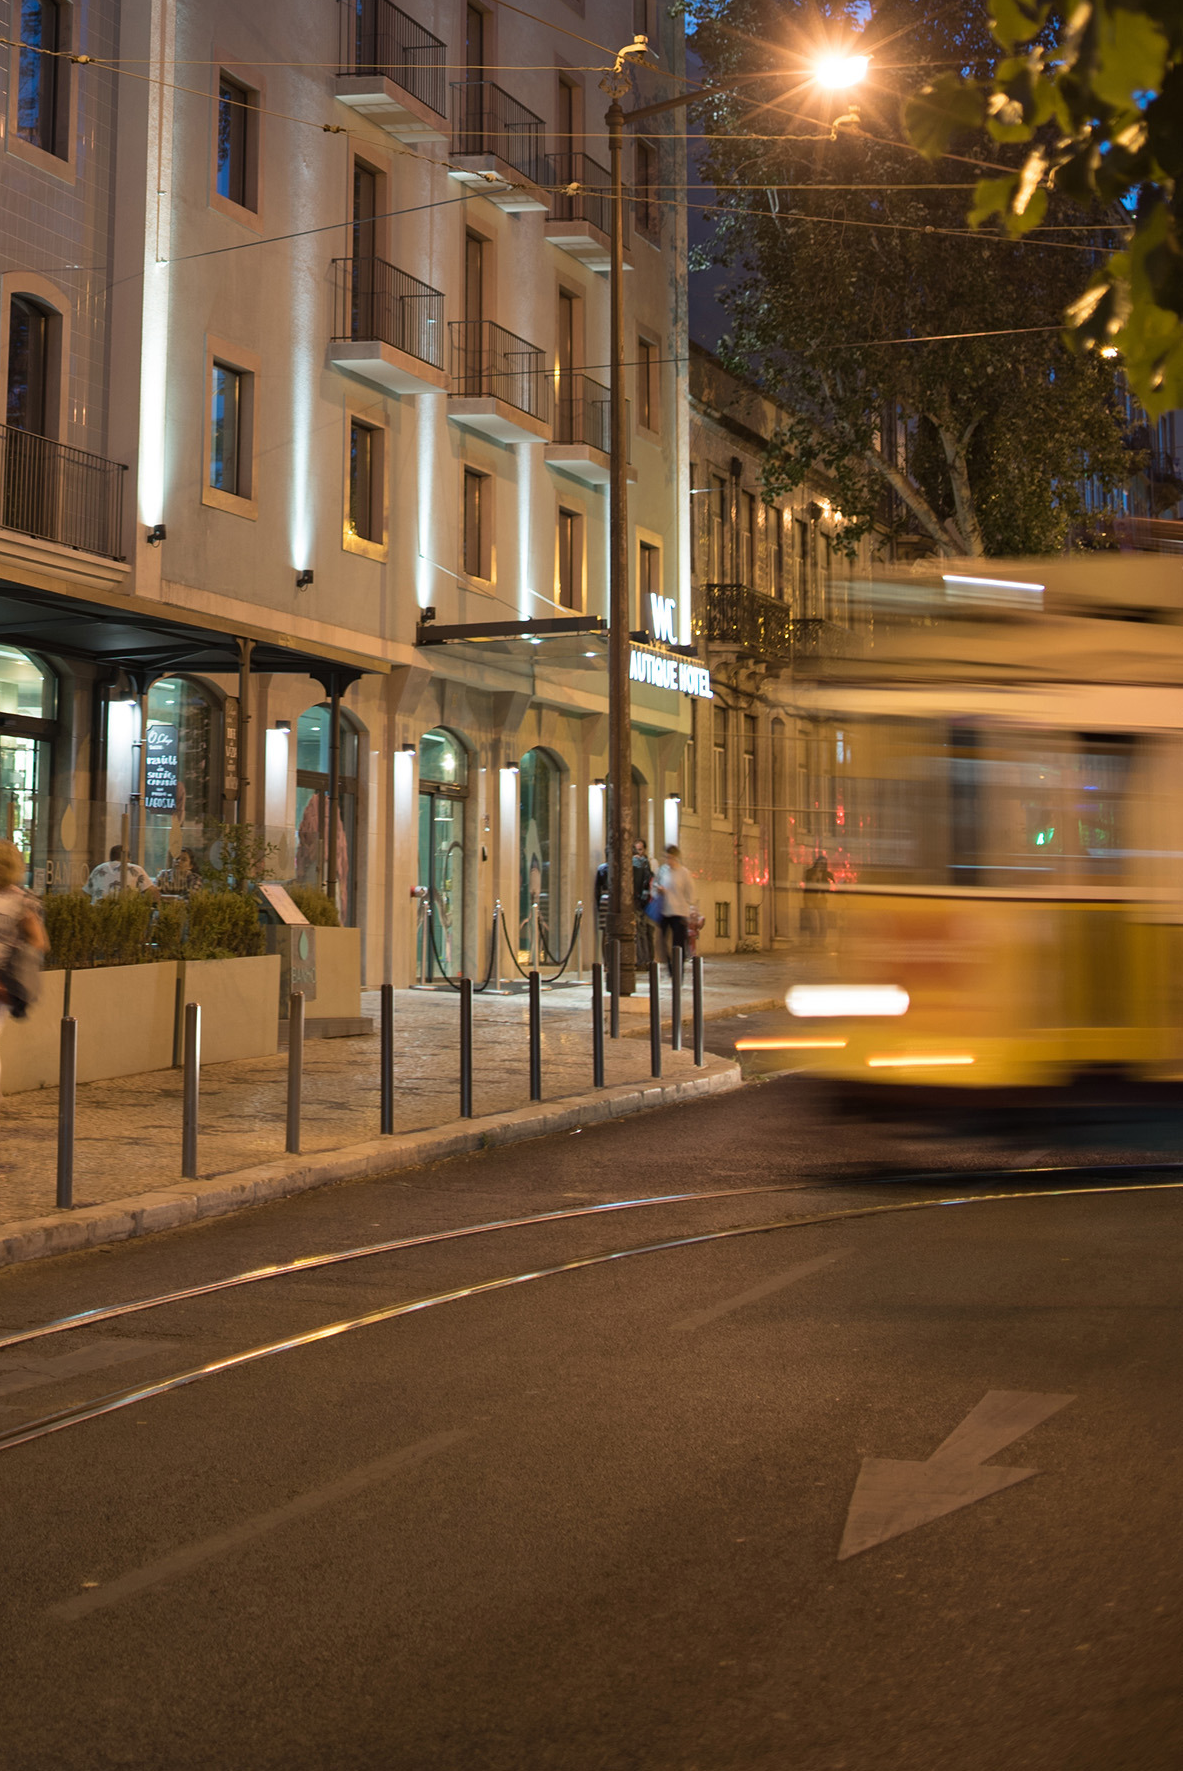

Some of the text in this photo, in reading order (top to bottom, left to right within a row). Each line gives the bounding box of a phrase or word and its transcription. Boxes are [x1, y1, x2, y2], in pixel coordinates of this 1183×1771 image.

[650, 592, 679, 646] WC
[629, 649, 714, 699] AUTIQUE HOTEL
[145, 797, 176, 808] LAGOSTA
